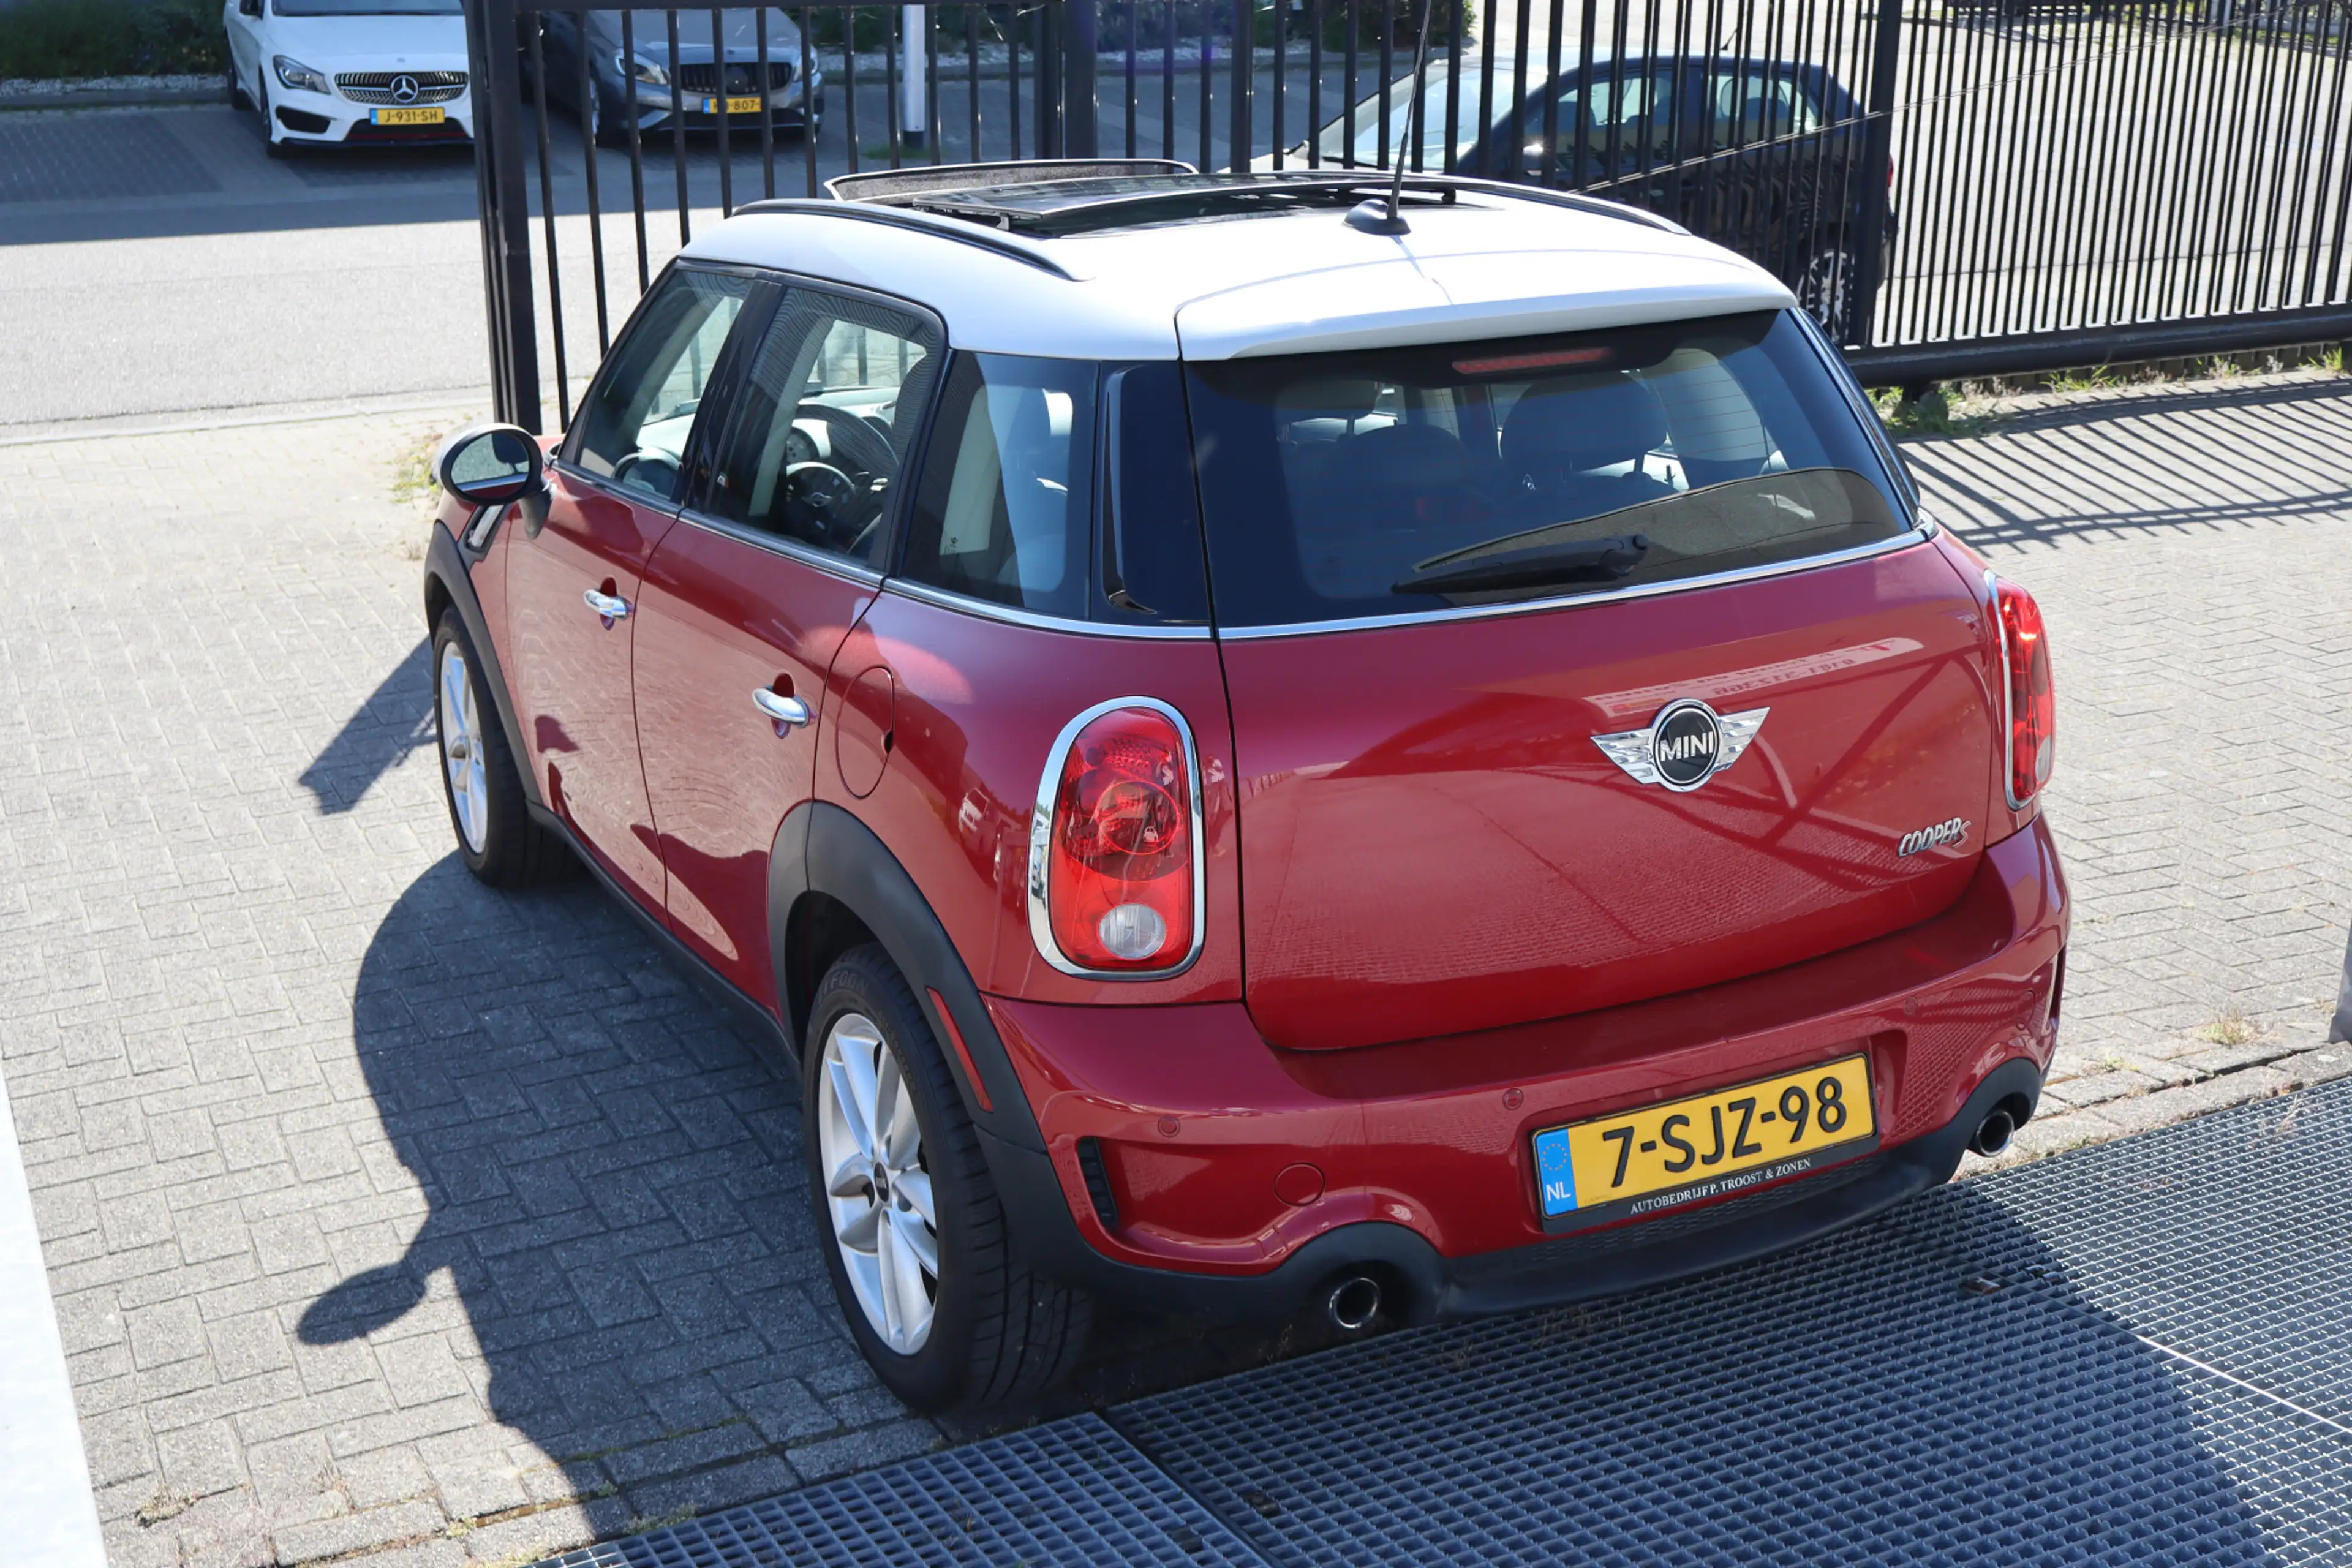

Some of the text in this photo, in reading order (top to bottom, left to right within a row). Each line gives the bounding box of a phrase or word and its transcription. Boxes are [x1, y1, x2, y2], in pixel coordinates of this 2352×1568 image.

[385, 110, 438, 123] J-931-SH
[1660, 731, 1714, 762] MINI
[1898, 816, 1972, 858] COOPER S
[1602, 1076, 1847, 1188] 7-SJZ-98
[1545, 1181, 1572, 1202] NL
[1630, 1186, 1708, 1215] AUTOBEDRIJF
[1709, 1183, 1719, 1194] P.
[1719, 1170, 1763, 1192] TROOST
[1765, 1168, 1774, 1180] &
[1775, 1158, 1812, 1178] ZONEN
